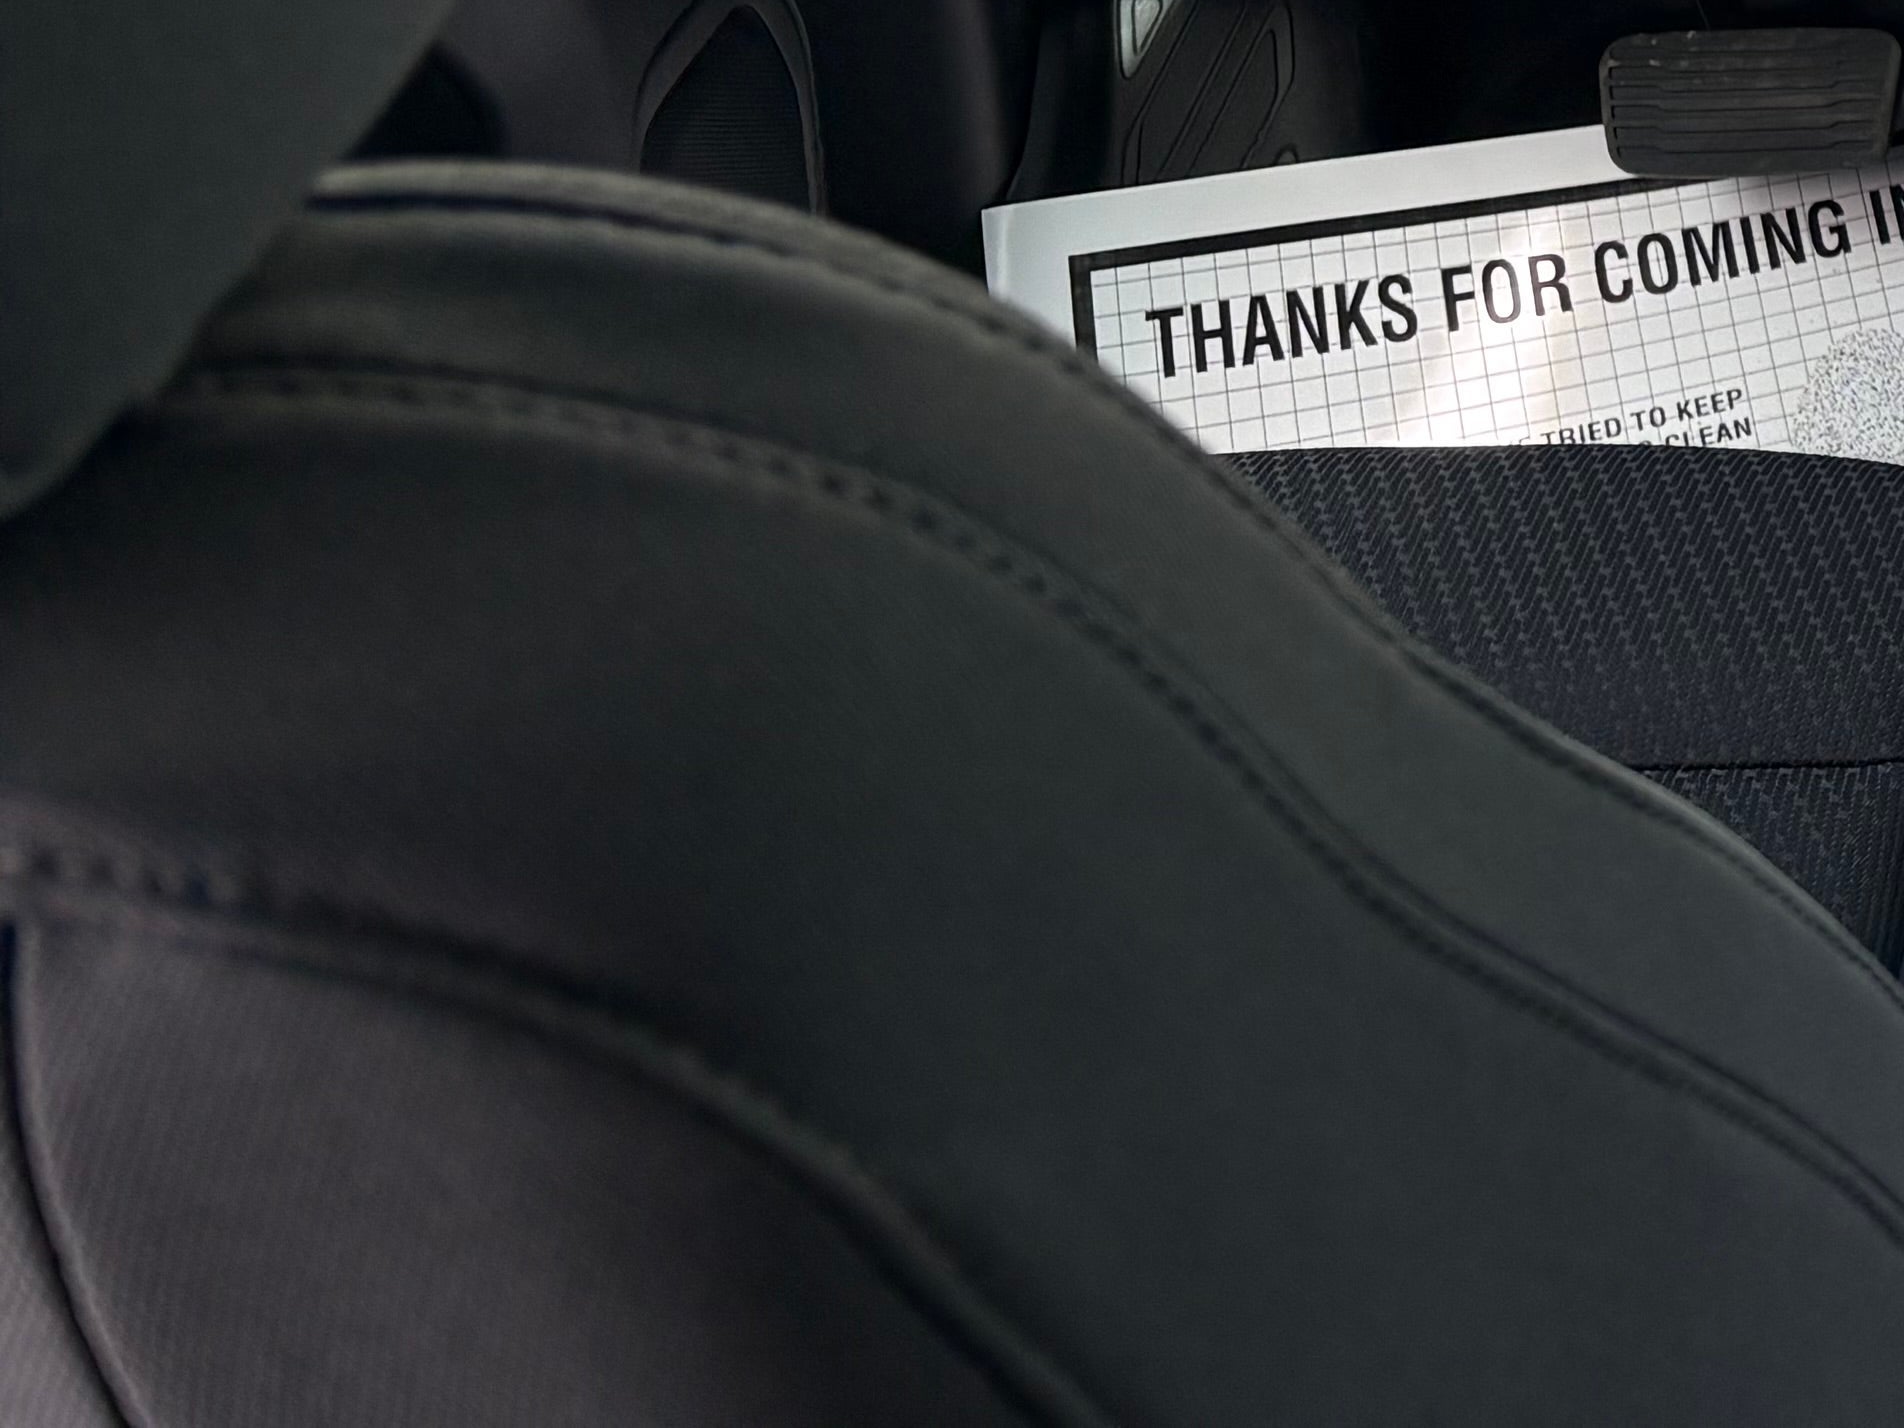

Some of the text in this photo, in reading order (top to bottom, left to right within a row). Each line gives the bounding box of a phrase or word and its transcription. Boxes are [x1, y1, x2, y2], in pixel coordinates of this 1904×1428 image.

[1145, 273, 1421, 378] THANKS
[1441, 251, 1572, 332] FOR
[1594, 198, 1850, 305] COMING
[1540, 387, 1744, 445] TRIED TO KEEP
[1664, 416, 1753, 446] CLEAN
